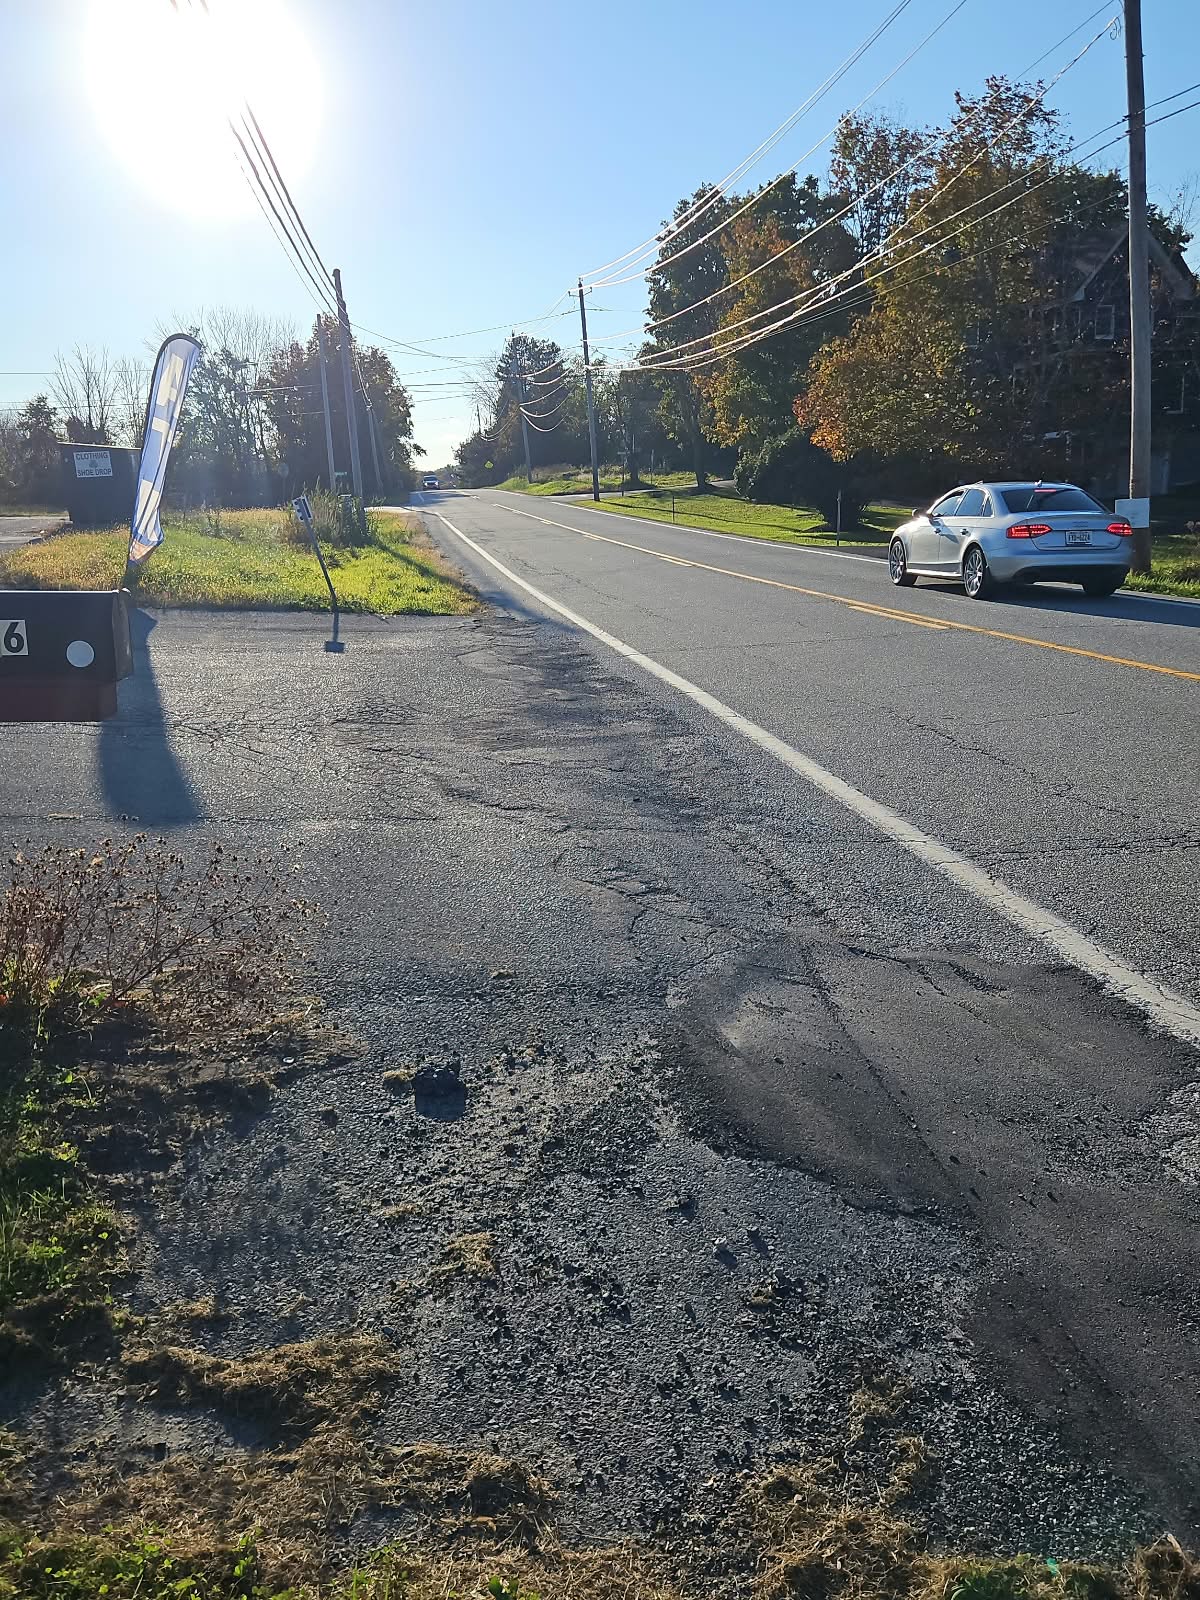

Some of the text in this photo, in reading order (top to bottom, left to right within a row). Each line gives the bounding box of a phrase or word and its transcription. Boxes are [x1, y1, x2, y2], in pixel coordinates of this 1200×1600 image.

[75, 452, 109, 460] CLOTHING
[95, 468, 111, 476] DROP
[3, 621, 25, 653] 6
